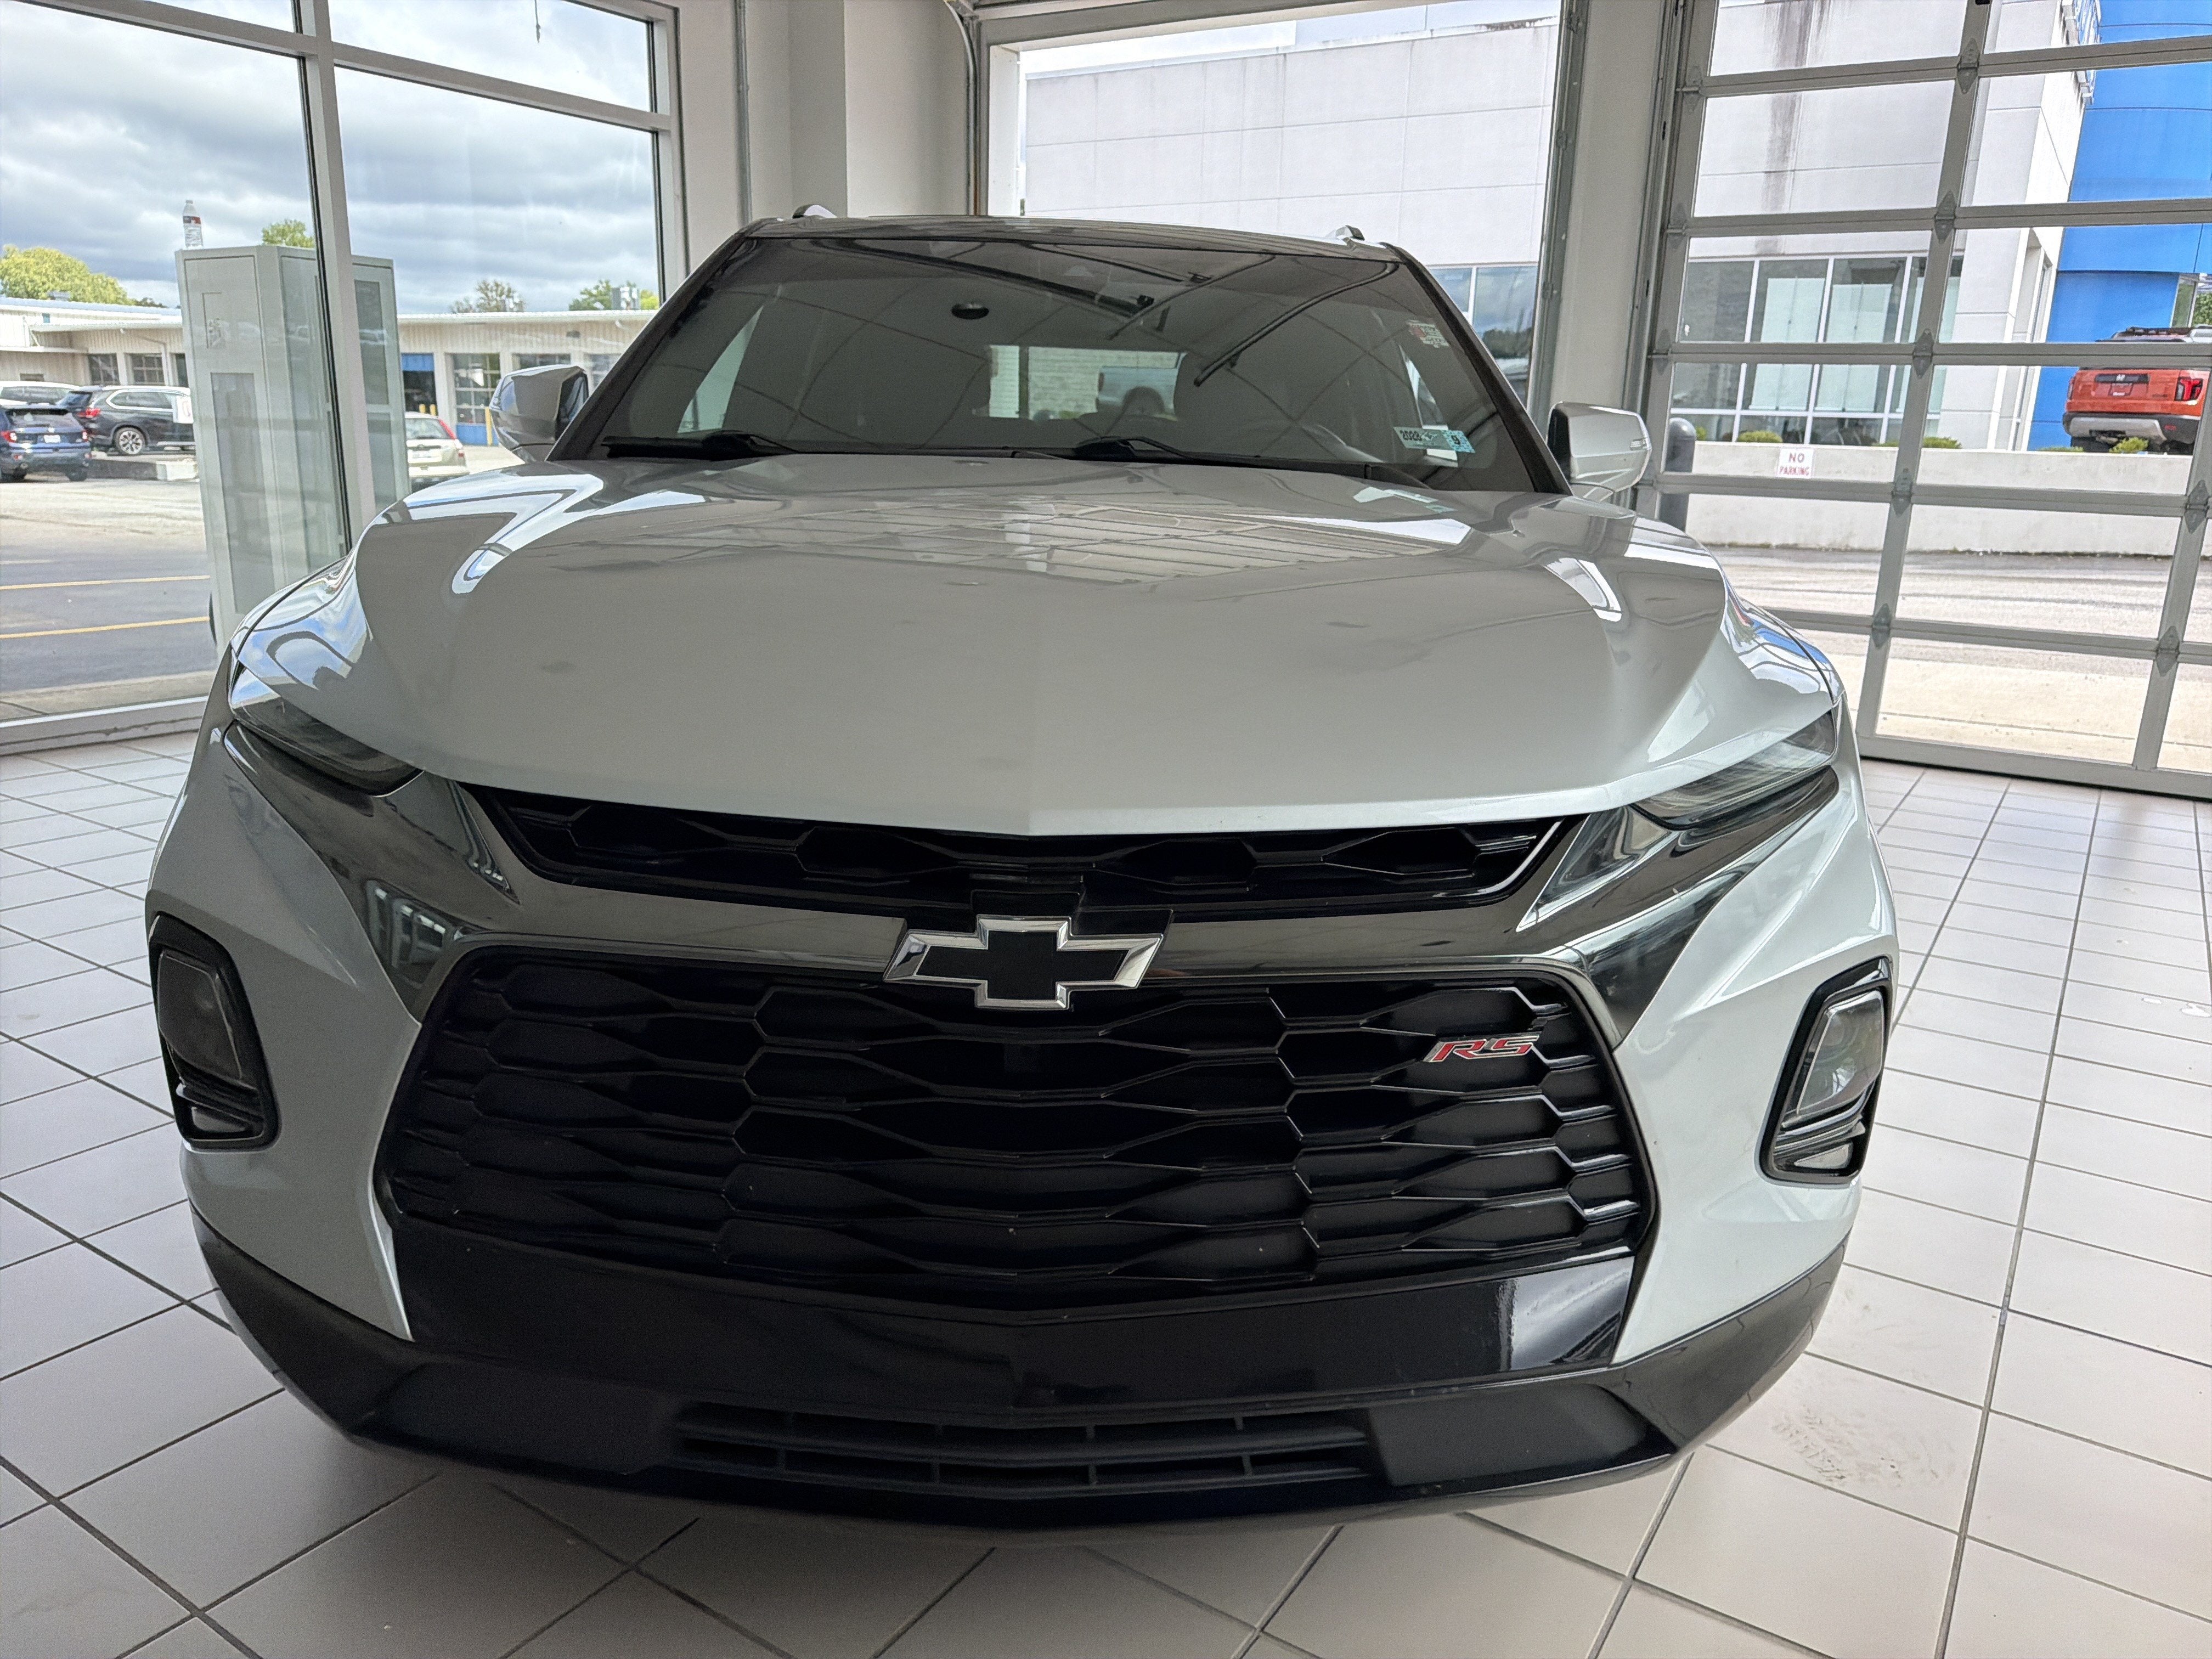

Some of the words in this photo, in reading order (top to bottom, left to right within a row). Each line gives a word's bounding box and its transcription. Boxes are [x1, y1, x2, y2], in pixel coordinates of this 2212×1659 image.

[1788, 452, 1805, 463] NO
[1779, 465, 1810, 476] PARKING
[1423, 1034, 1540, 1063] RS
